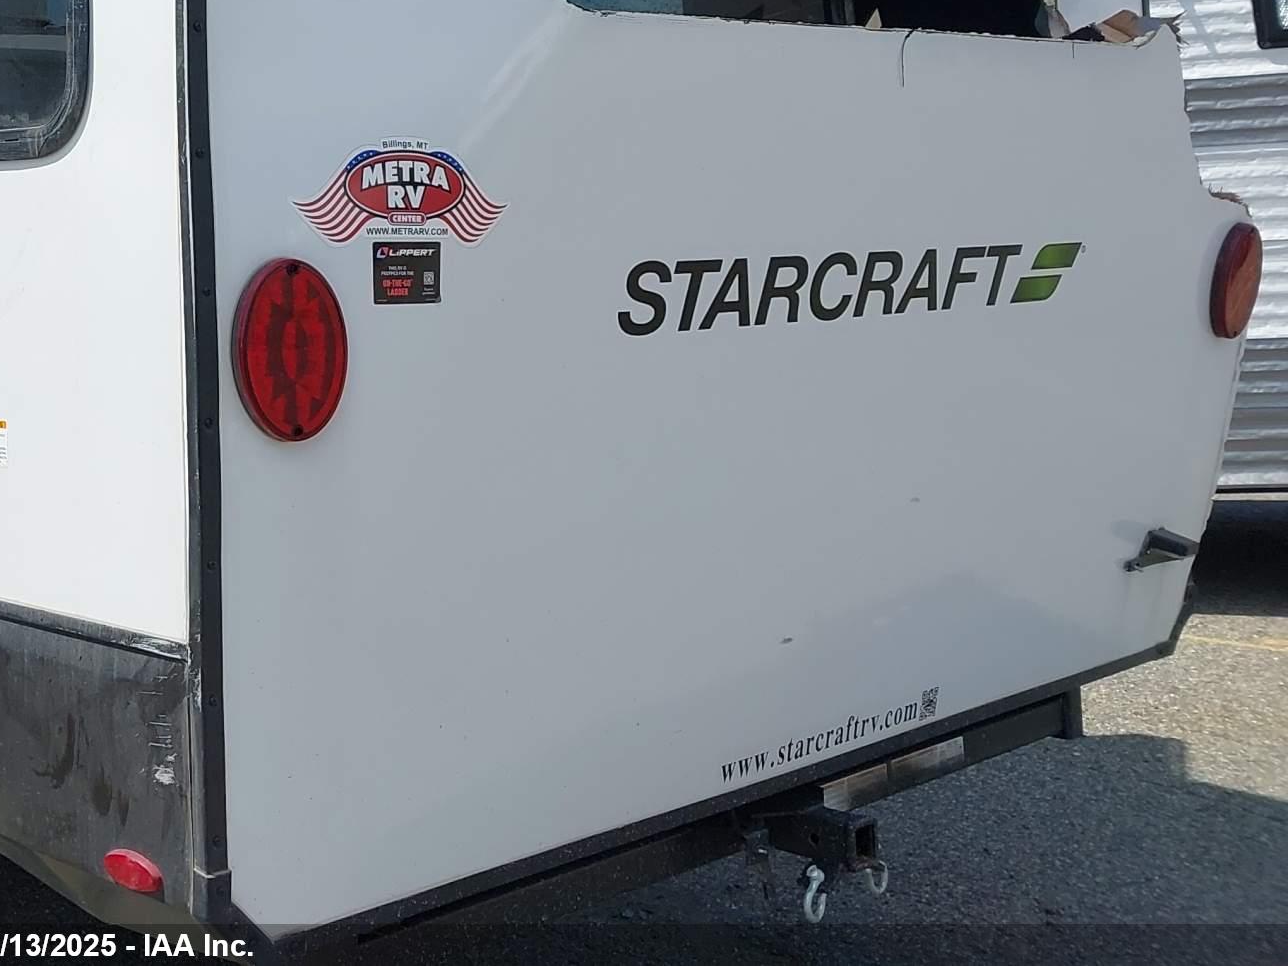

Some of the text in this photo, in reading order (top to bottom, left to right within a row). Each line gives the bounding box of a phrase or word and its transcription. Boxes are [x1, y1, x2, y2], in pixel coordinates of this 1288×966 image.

[382, 140, 429, 150] Billings, MT
[361, 160, 450, 191] METRA
[387, 185, 426, 209] RV
[392, 215, 423, 223] CENTER
[365, 227, 449, 236] WWW.METRARV.COM
[618, 244, 1022, 336] STARCRAFT
[720, 700, 918, 784] www.starcraftrv.com
